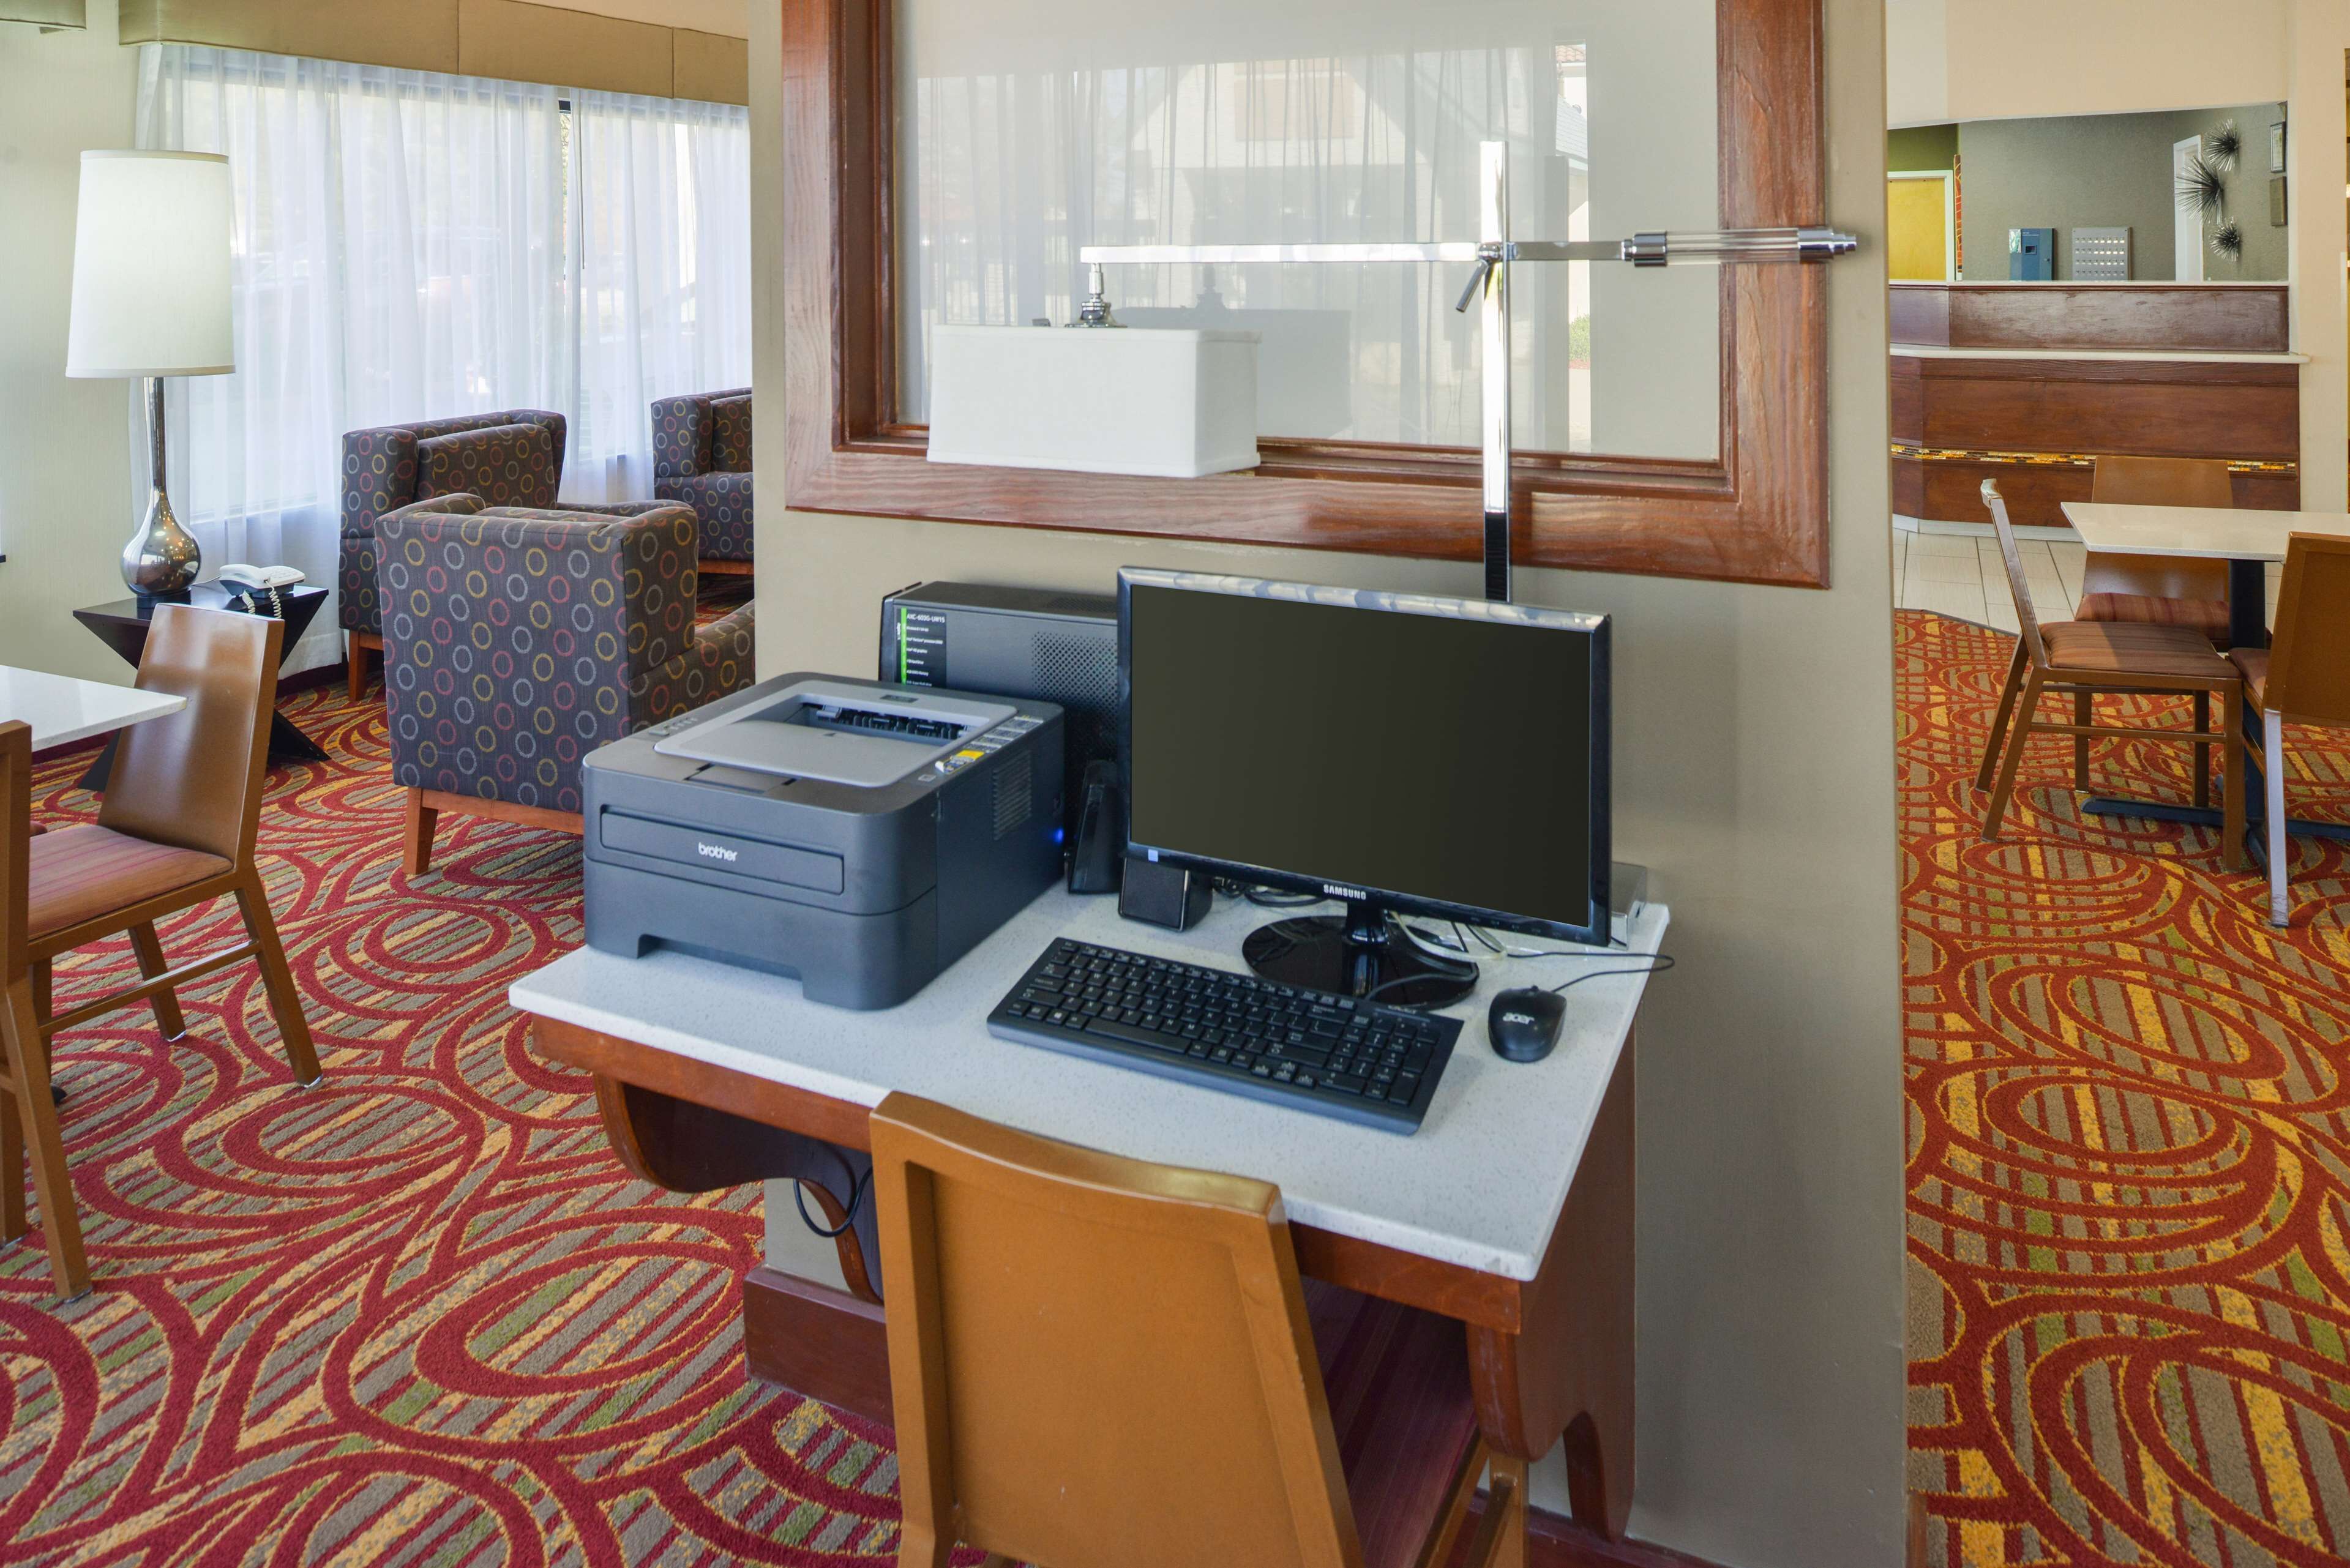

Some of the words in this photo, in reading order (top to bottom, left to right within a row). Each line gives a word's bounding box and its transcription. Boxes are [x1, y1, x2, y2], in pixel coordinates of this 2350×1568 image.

[698, 842, 738, 862] brother
[1323, 884, 1366, 900] SAMSUNG
[1503, 1012, 1535, 1025] acer
